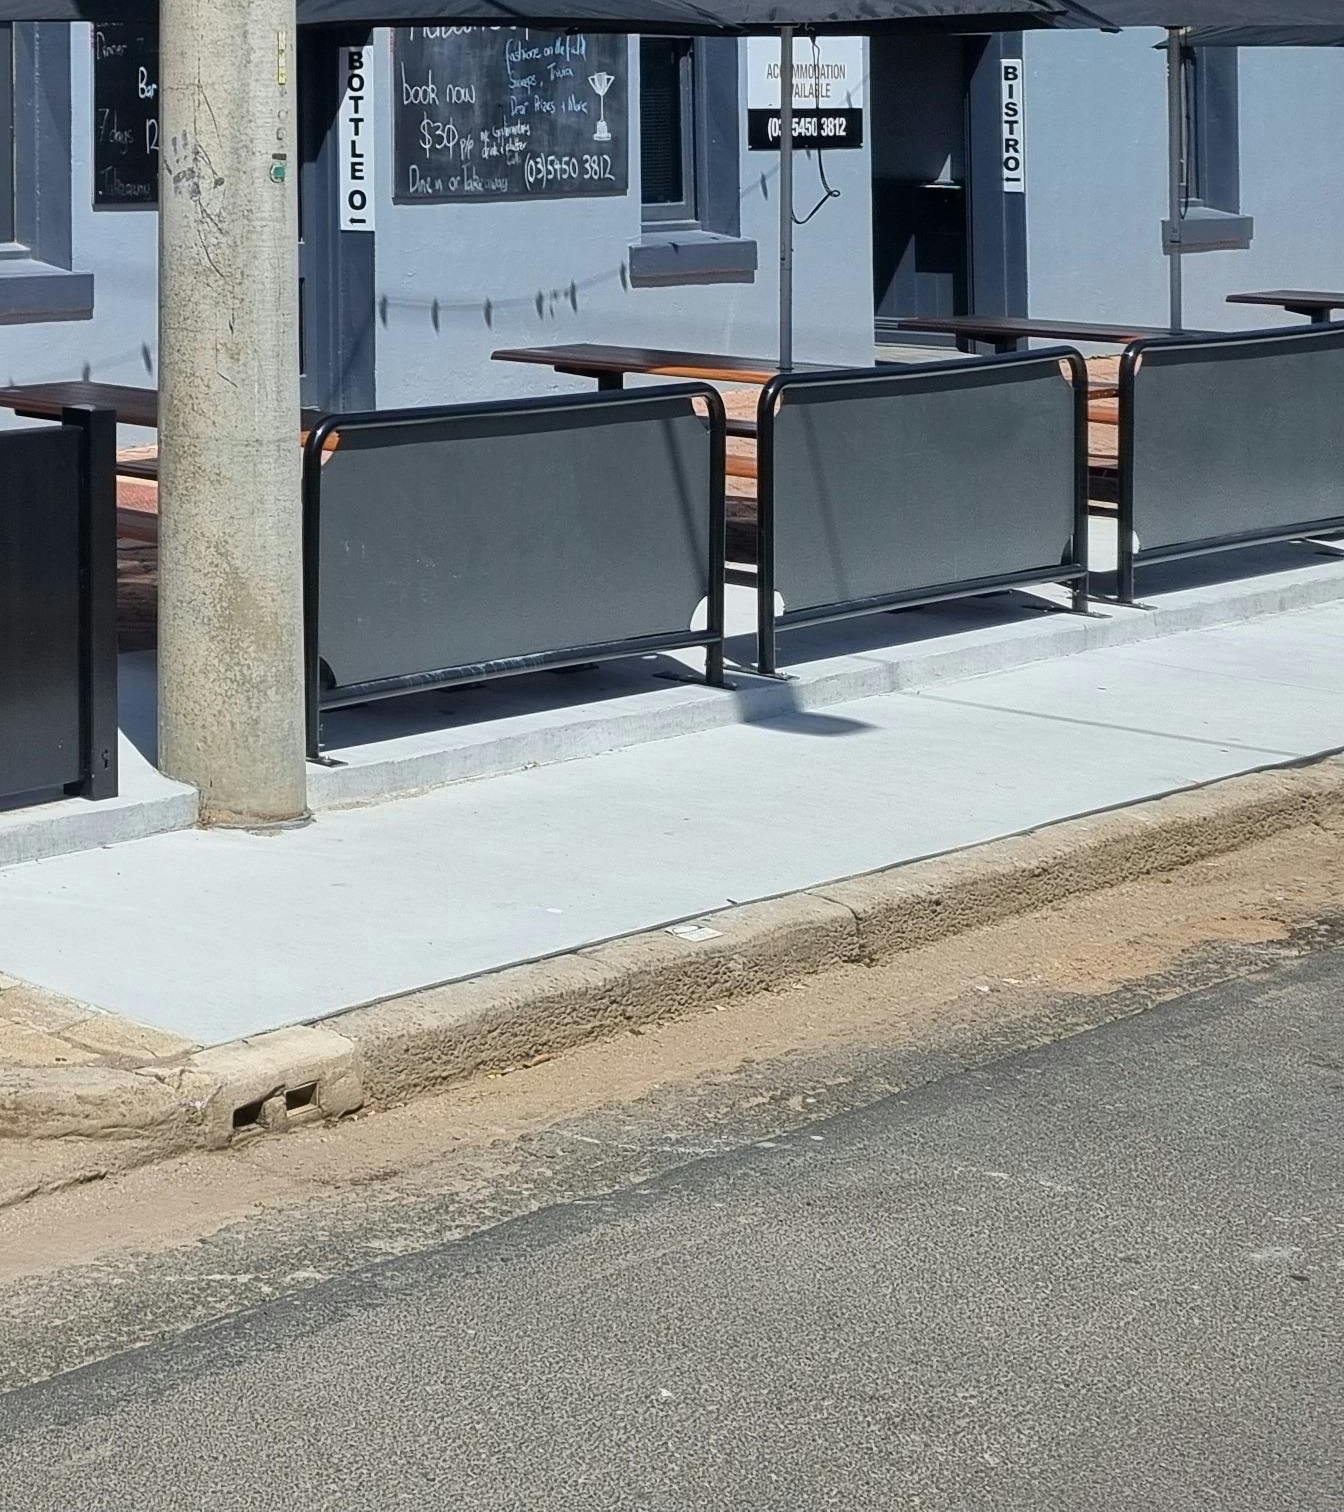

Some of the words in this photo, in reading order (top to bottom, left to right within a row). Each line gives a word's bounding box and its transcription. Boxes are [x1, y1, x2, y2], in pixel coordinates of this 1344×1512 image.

[401, 61, 439, 105] book
[446, 84, 476, 104] now
[348, 51, 365, 181] BOTTLE
[791, 117, 817, 137] 5450
[820, 117, 847, 136] 3812
[1003, 65, 1020, 172] BISTRO
[582, 154, 615, 181] 3812
[348, 189, 367, 211] O
